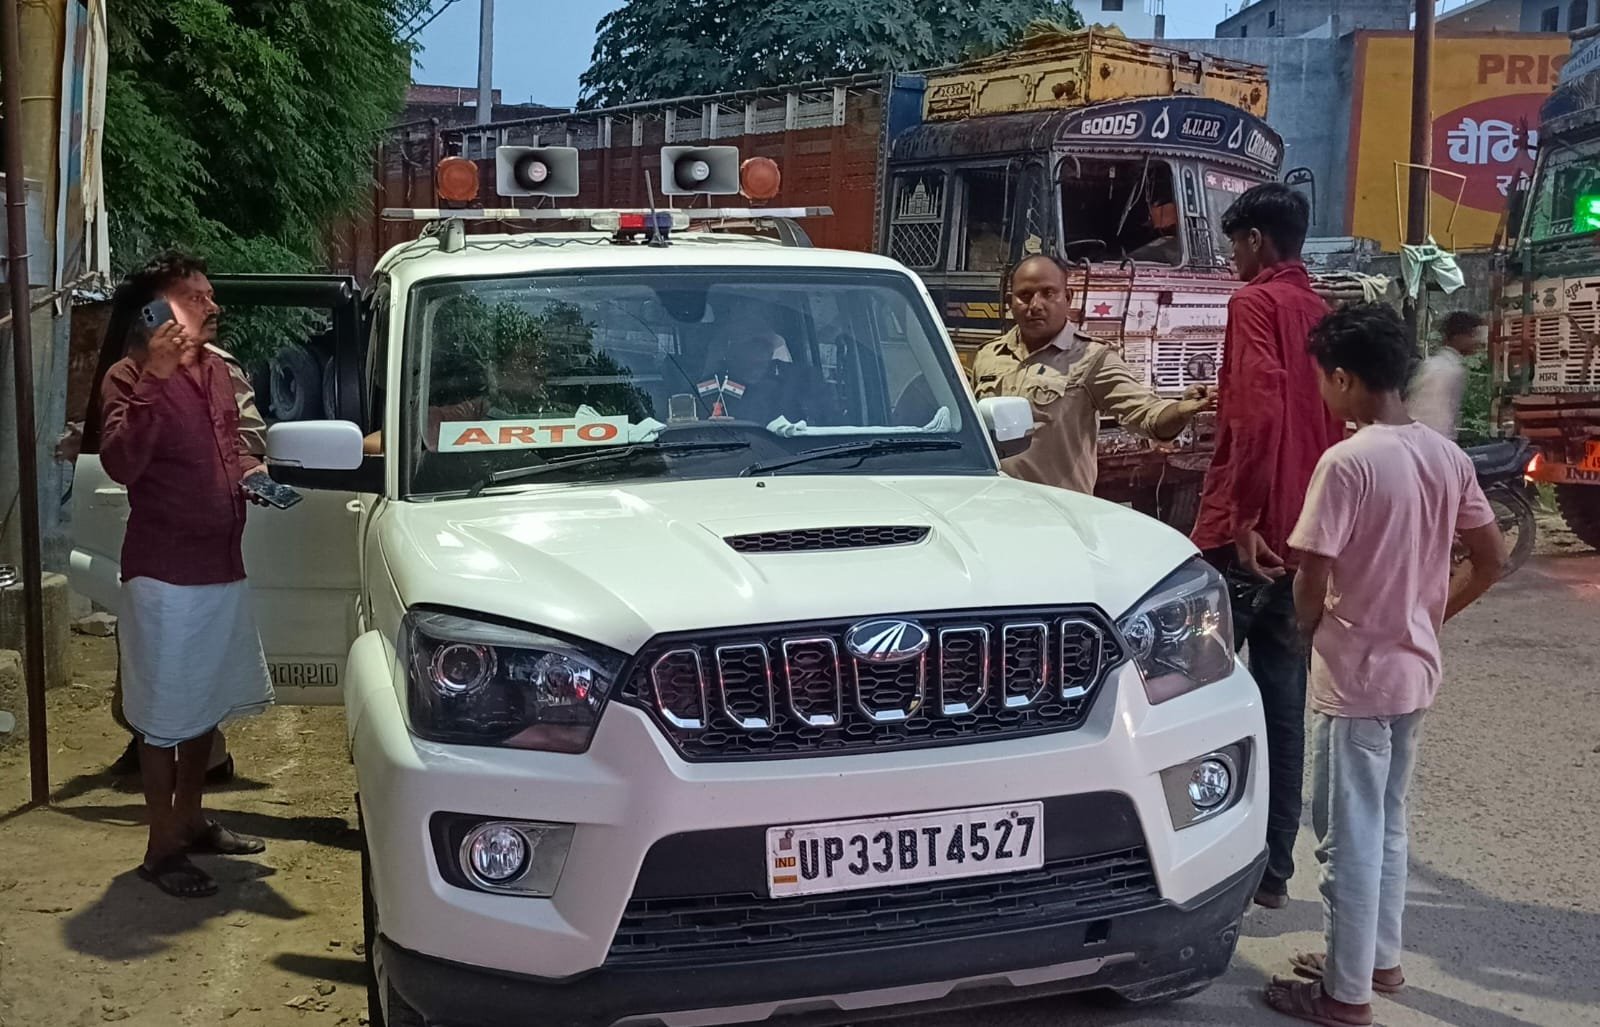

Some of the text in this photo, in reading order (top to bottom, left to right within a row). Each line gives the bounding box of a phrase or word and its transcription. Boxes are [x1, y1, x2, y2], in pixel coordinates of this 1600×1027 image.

[1081, 113, 1137, 135] GOODS
[452, 423, 618, 446] ARTO
[799, 817, 1035, 880] UP33BT4527
[775, 857, 796, 868] IND
